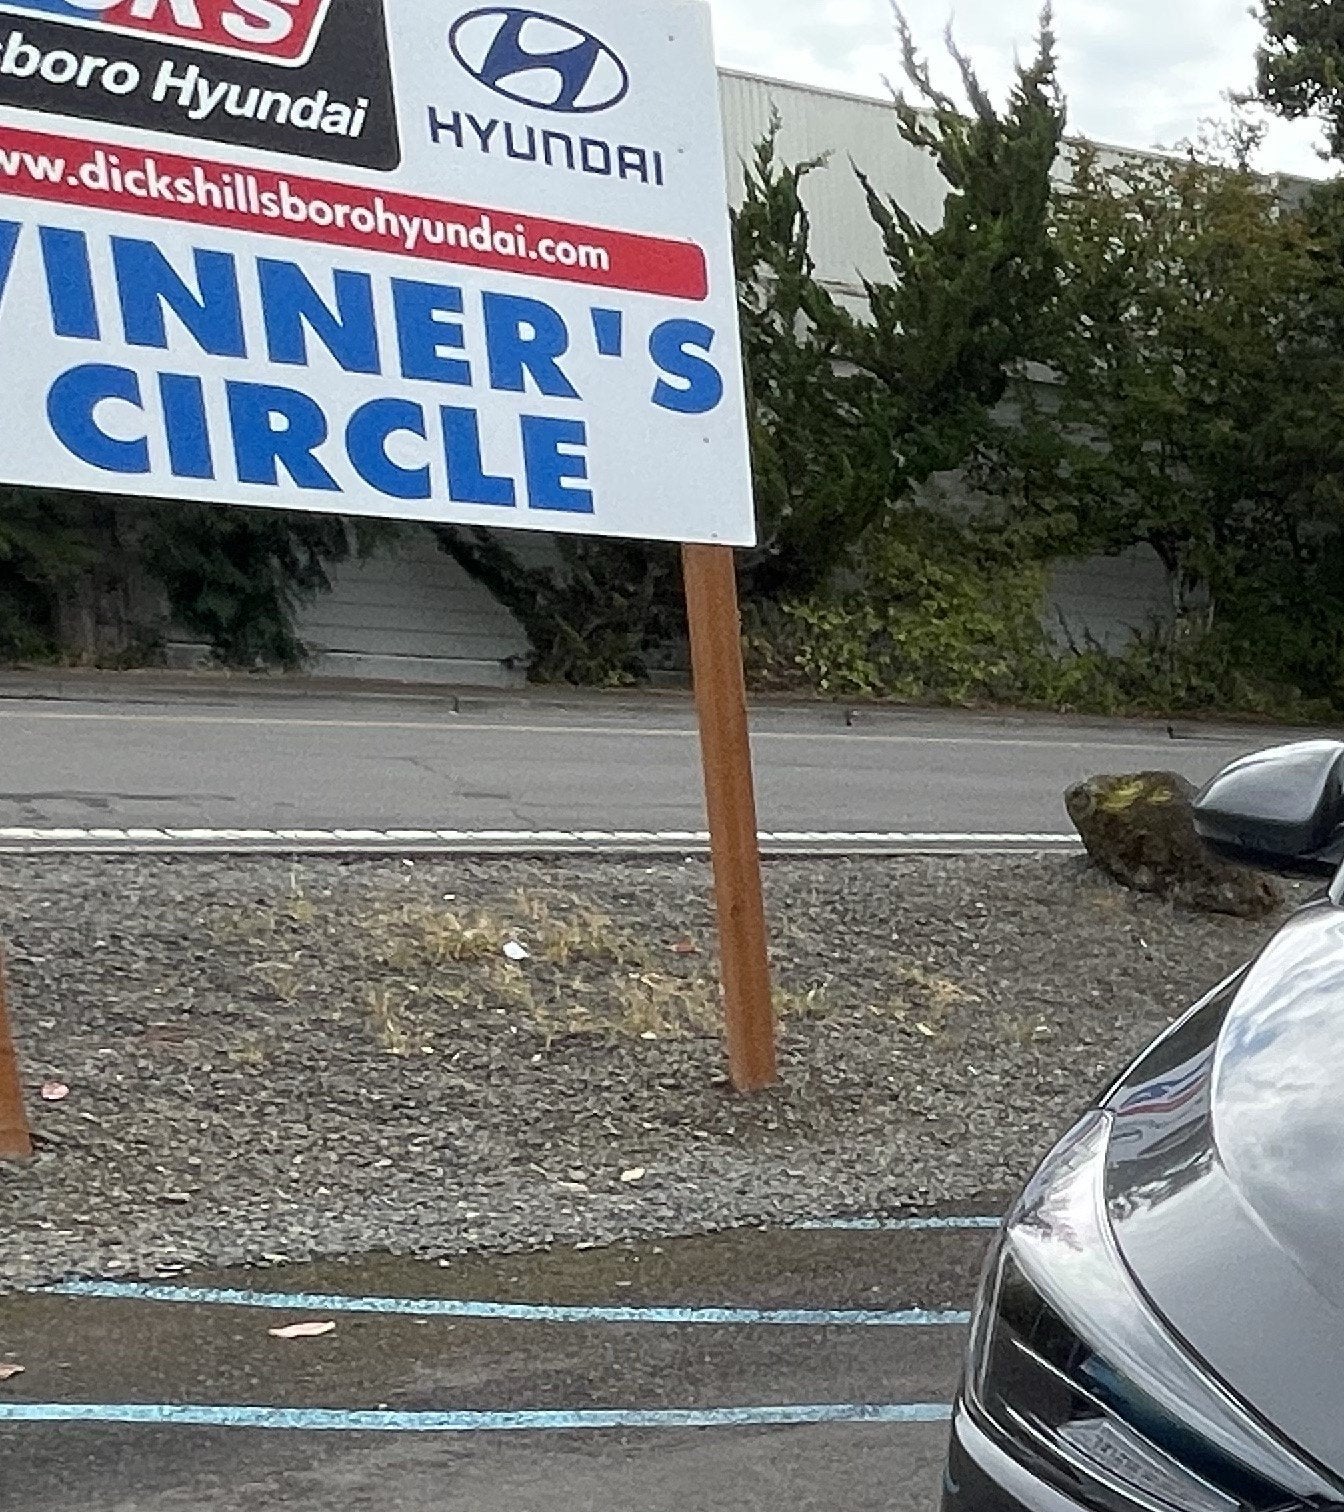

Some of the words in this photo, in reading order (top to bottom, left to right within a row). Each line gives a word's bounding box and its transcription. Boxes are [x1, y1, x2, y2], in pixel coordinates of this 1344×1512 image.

[0, 31, 140, 95] boro
[151, 60, 370, 138] Hyundai
[427, 105, 663, 187] HYUNDAI
[0, 220, 725, 415] INNER'S
[46, 362, 595, 515] CIRCLE
